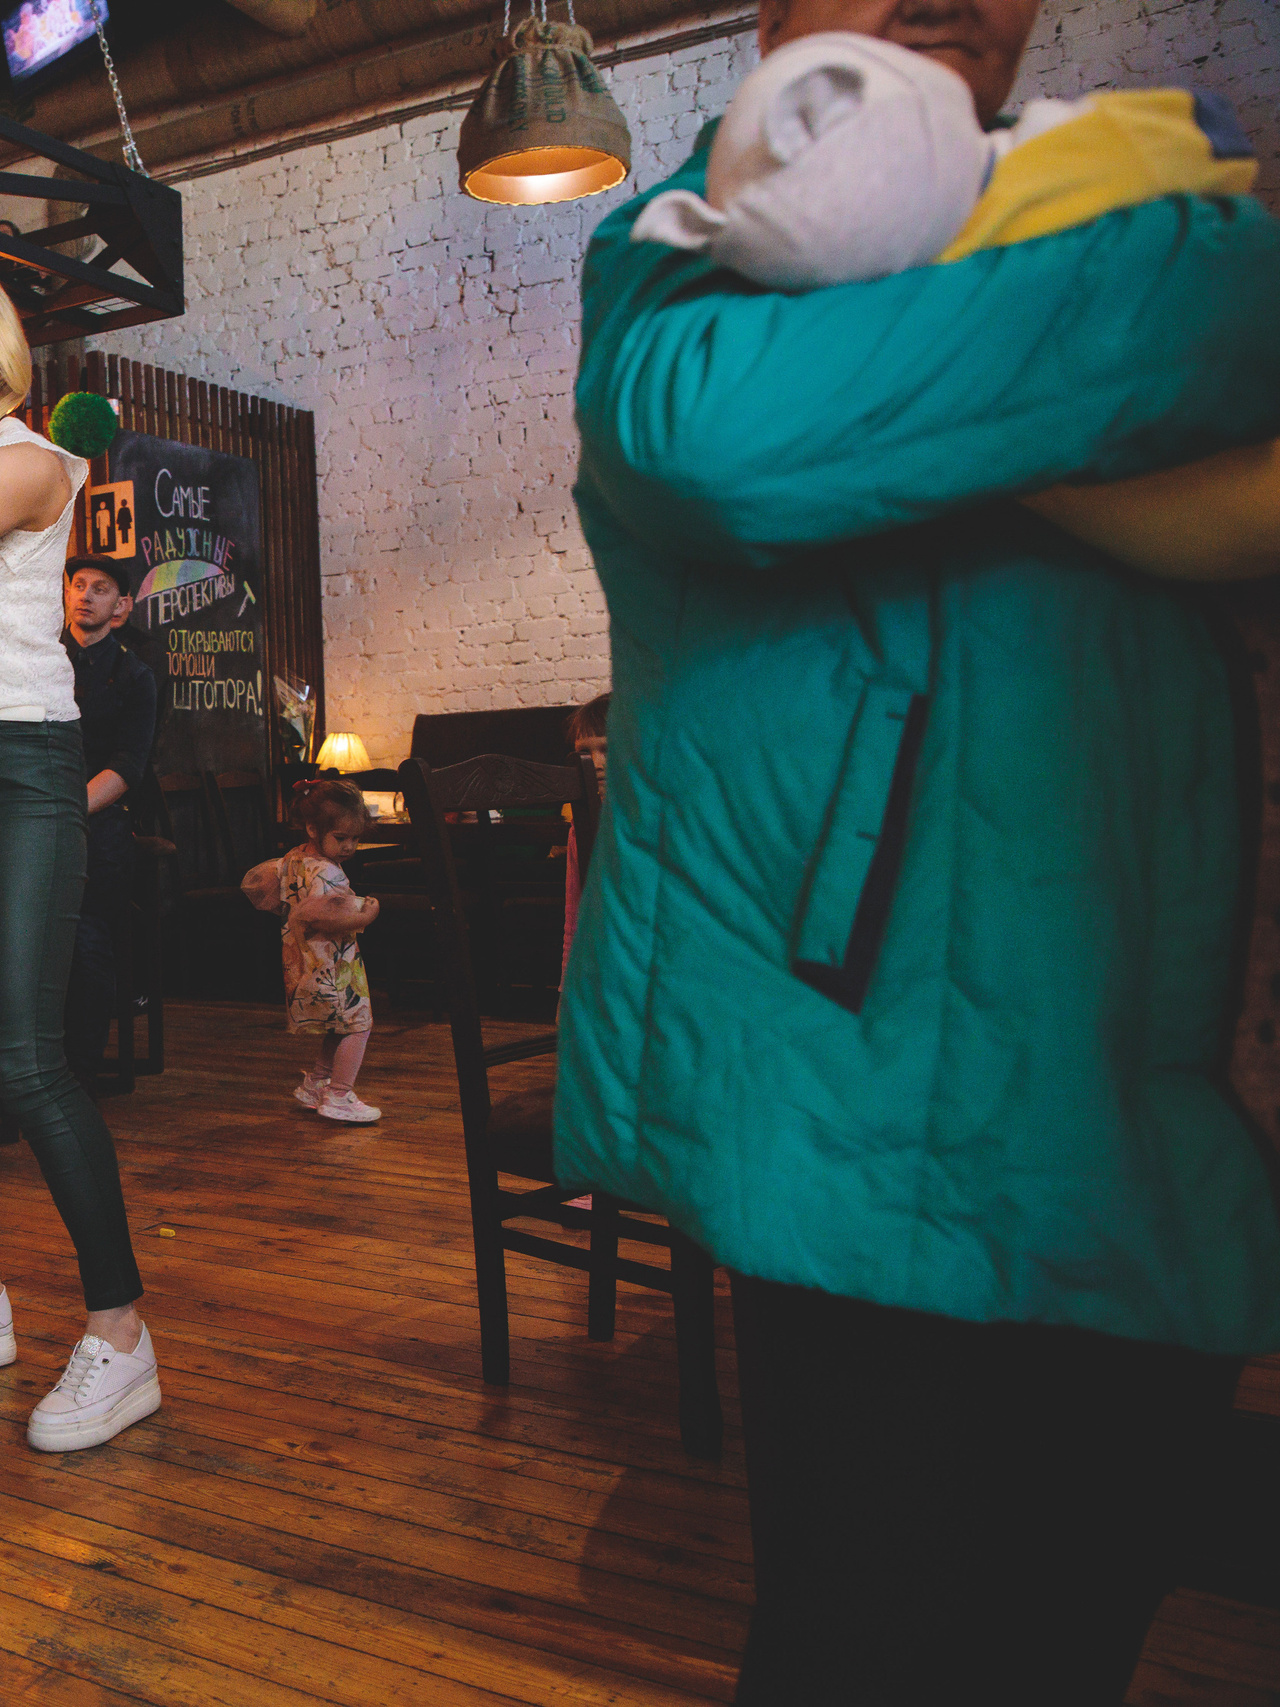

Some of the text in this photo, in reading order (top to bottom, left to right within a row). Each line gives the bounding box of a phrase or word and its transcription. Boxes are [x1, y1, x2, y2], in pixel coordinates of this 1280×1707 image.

[141, 527, 236, 572] РАДУЖНЫЕ
[147, 573, 235, 629] ПЕРСПЕКТИВЫ
[168, 628, 254, 653] ОТКРЫВАЮТСЯ
[173, 669, 263, 716] ШТОПОРА!
